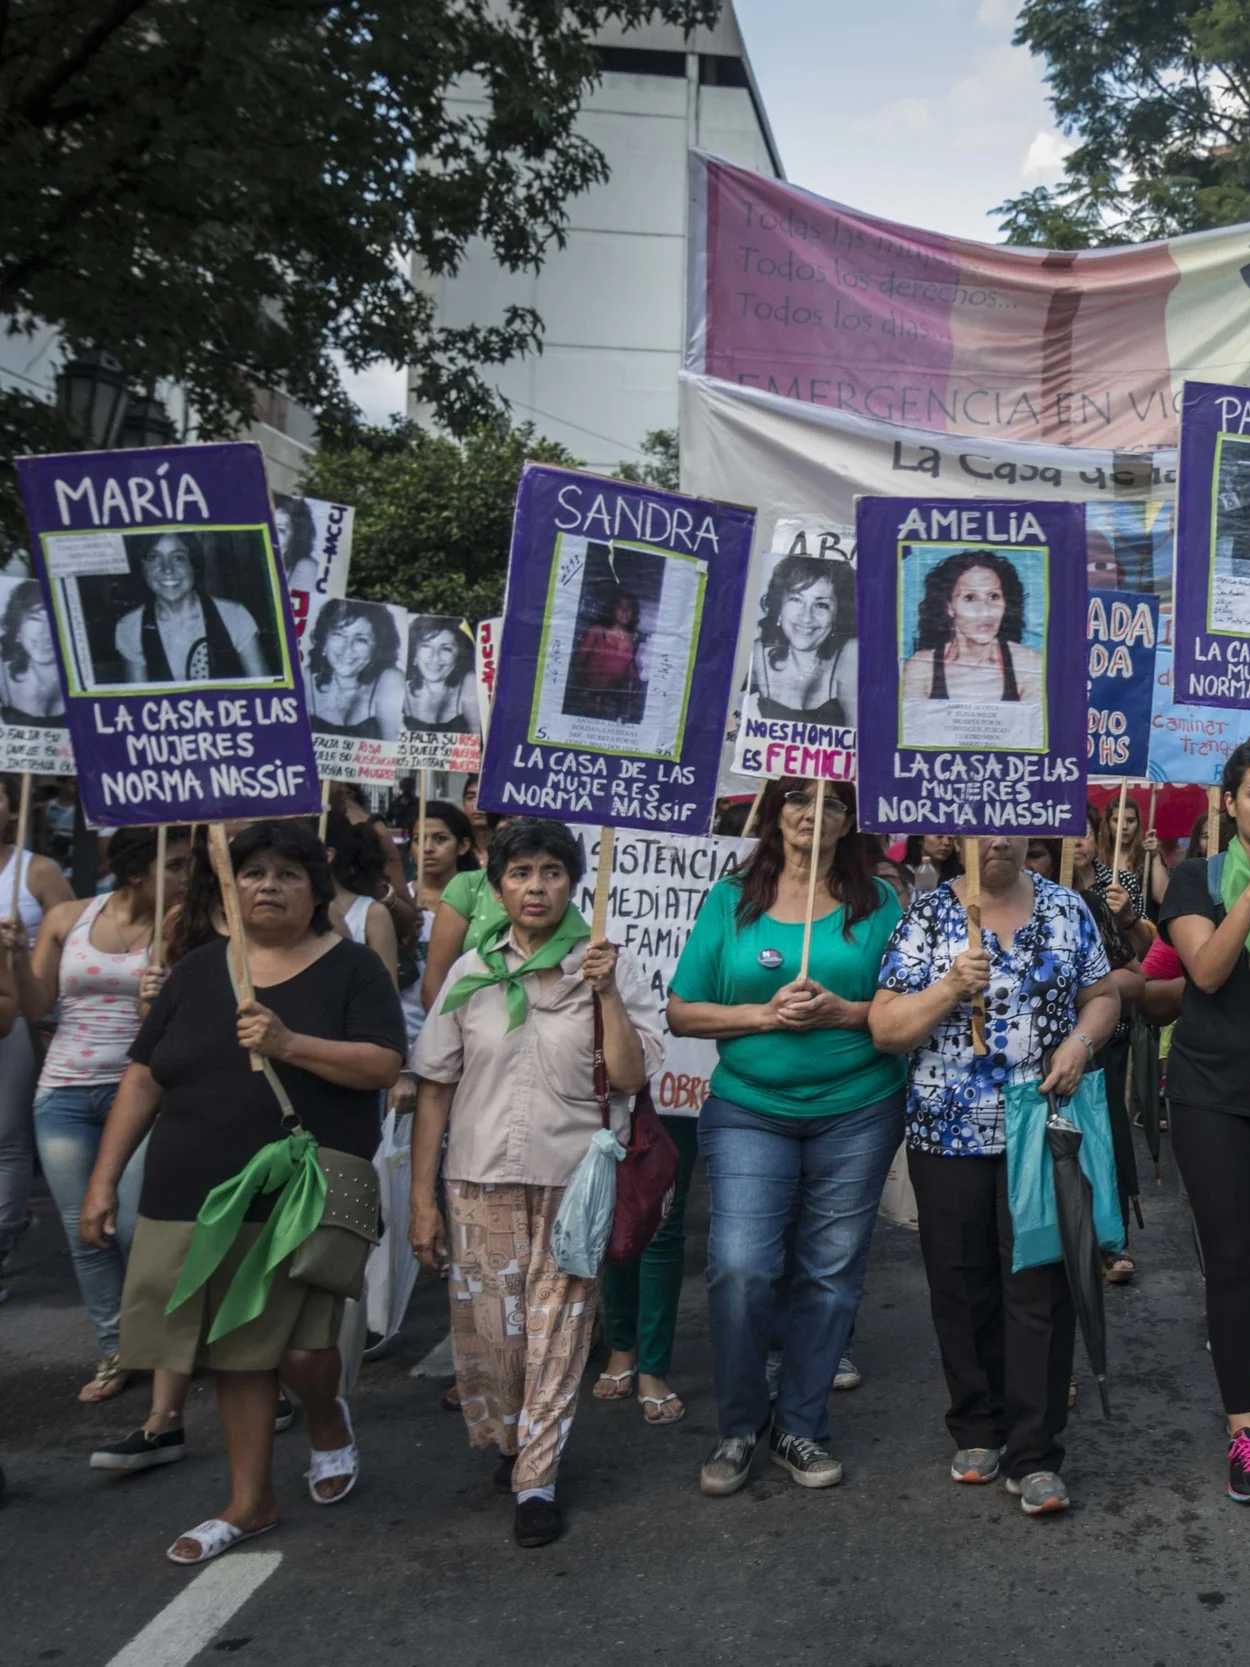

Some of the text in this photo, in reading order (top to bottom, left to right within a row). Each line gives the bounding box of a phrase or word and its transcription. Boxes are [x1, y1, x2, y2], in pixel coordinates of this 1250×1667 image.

[741, 202, 875, 250] Todas las
[739, 245, 828, 286] Todos
[834, 258, 870, 292] los
[736, 292, 824, 328] Todos
[834, 301, 873, 332] los
[1055, 391, 1111, 426] EN
[892, 441, 940, 478] La
[54, 462, 209, 526] MARÍA
[555, 485, 719, 553] SANDRA
[1195, 637, 1221, 662] LA
[94, 697, 298, 734] LA CASA DE LAS
[746, 718, 768, 739] NO
[769, 722, 789, 741] ES
[126, 732, 254, 767] MUJERES
[514, 745, 543, 770] LA
[550, 752, 607, 776] CASA
[619, 759, 649, 779] DE
[657, 763, 695, 784] LAS
[742, 748, 762, 771] ES
[894, 752, 1080, 782] LA CASA DE LAS
[101, 771, 202, 806] NORMA
[503, 782, 592, 812] NORMA
[550, 772, 660, 801] MUJERES
[921, 780, 1032, 802] MUJERES
[878, 797, 977, 826] NORMA
